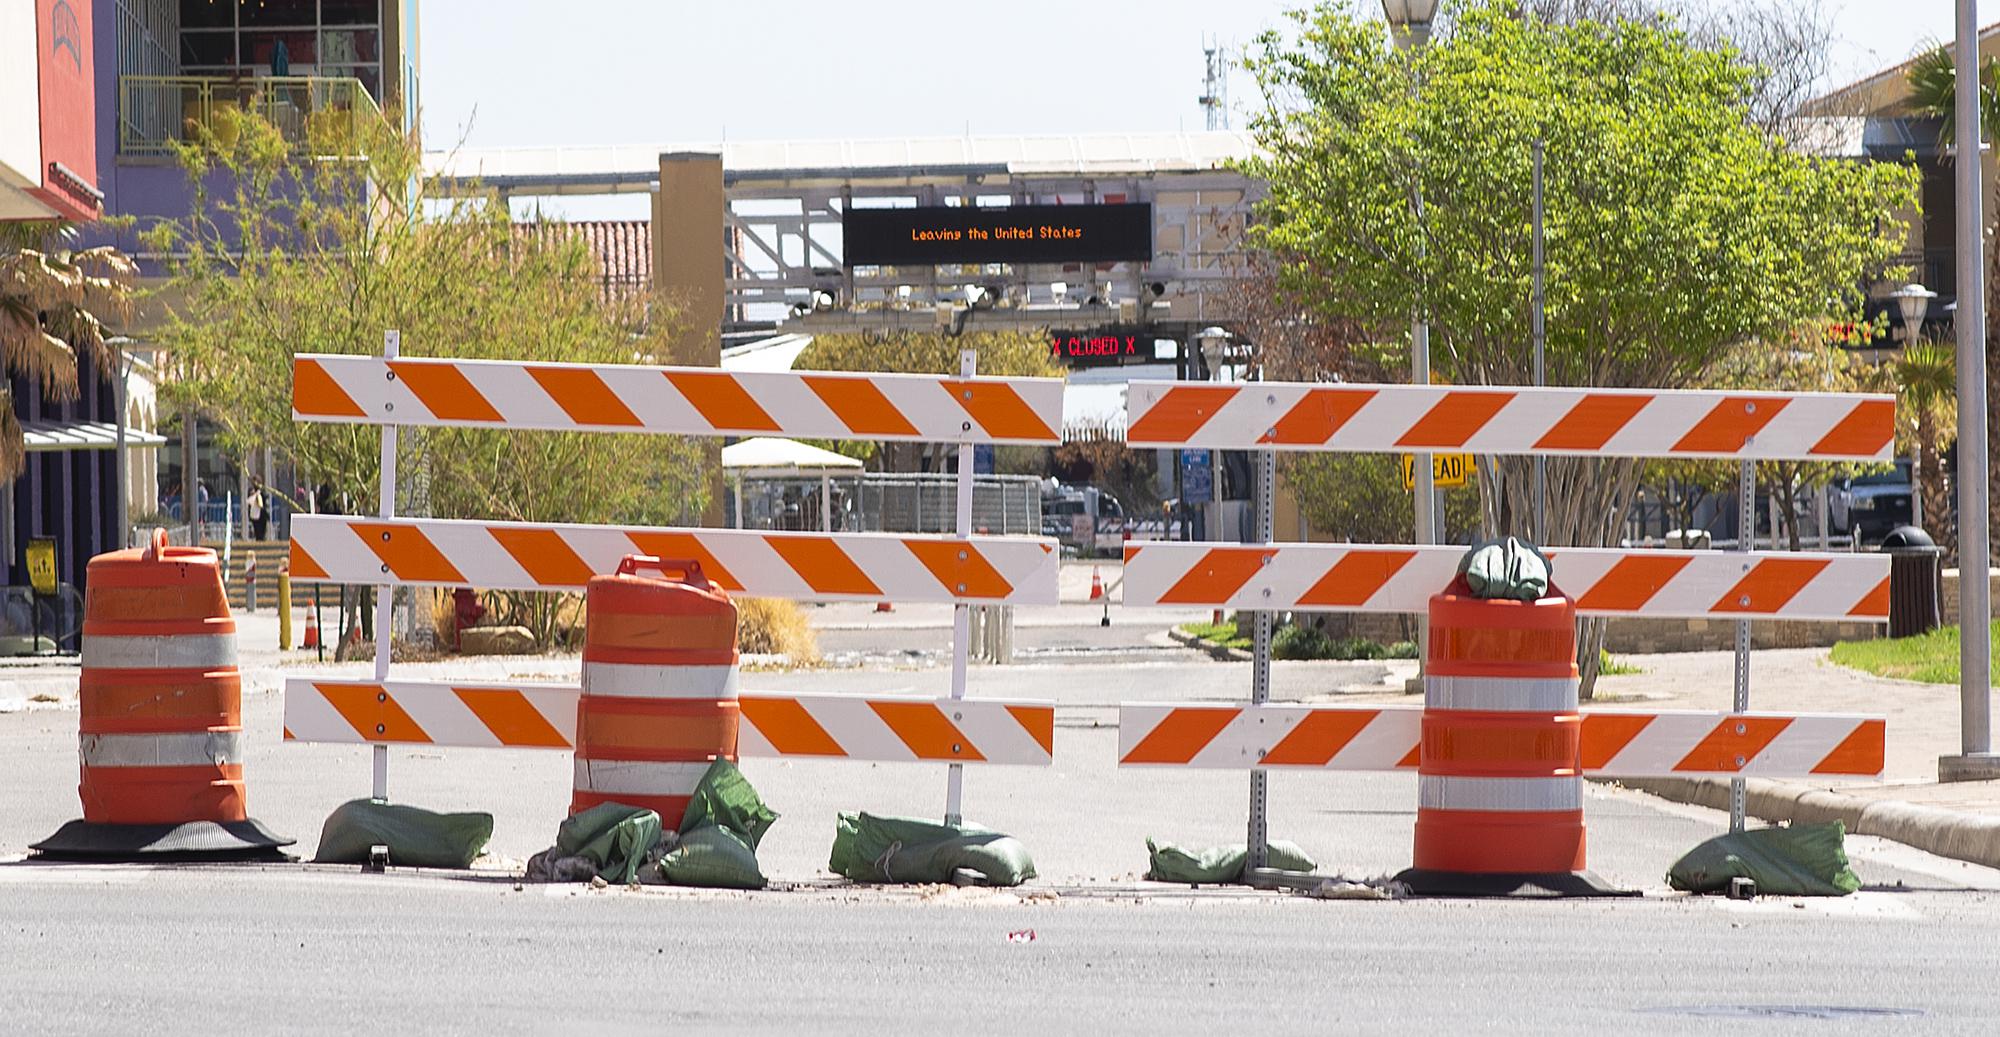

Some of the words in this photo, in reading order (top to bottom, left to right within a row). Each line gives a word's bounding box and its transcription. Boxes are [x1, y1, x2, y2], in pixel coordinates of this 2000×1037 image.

[912, 228, 961, 241] Leaving
[968, 227, 988, 240] the
[995, 227, 1033, 239] United
[1040, 226, 1081, 239] States
[1125, 336, 1135, 354] X
[1409, 457, 1461, 481] AEAD
